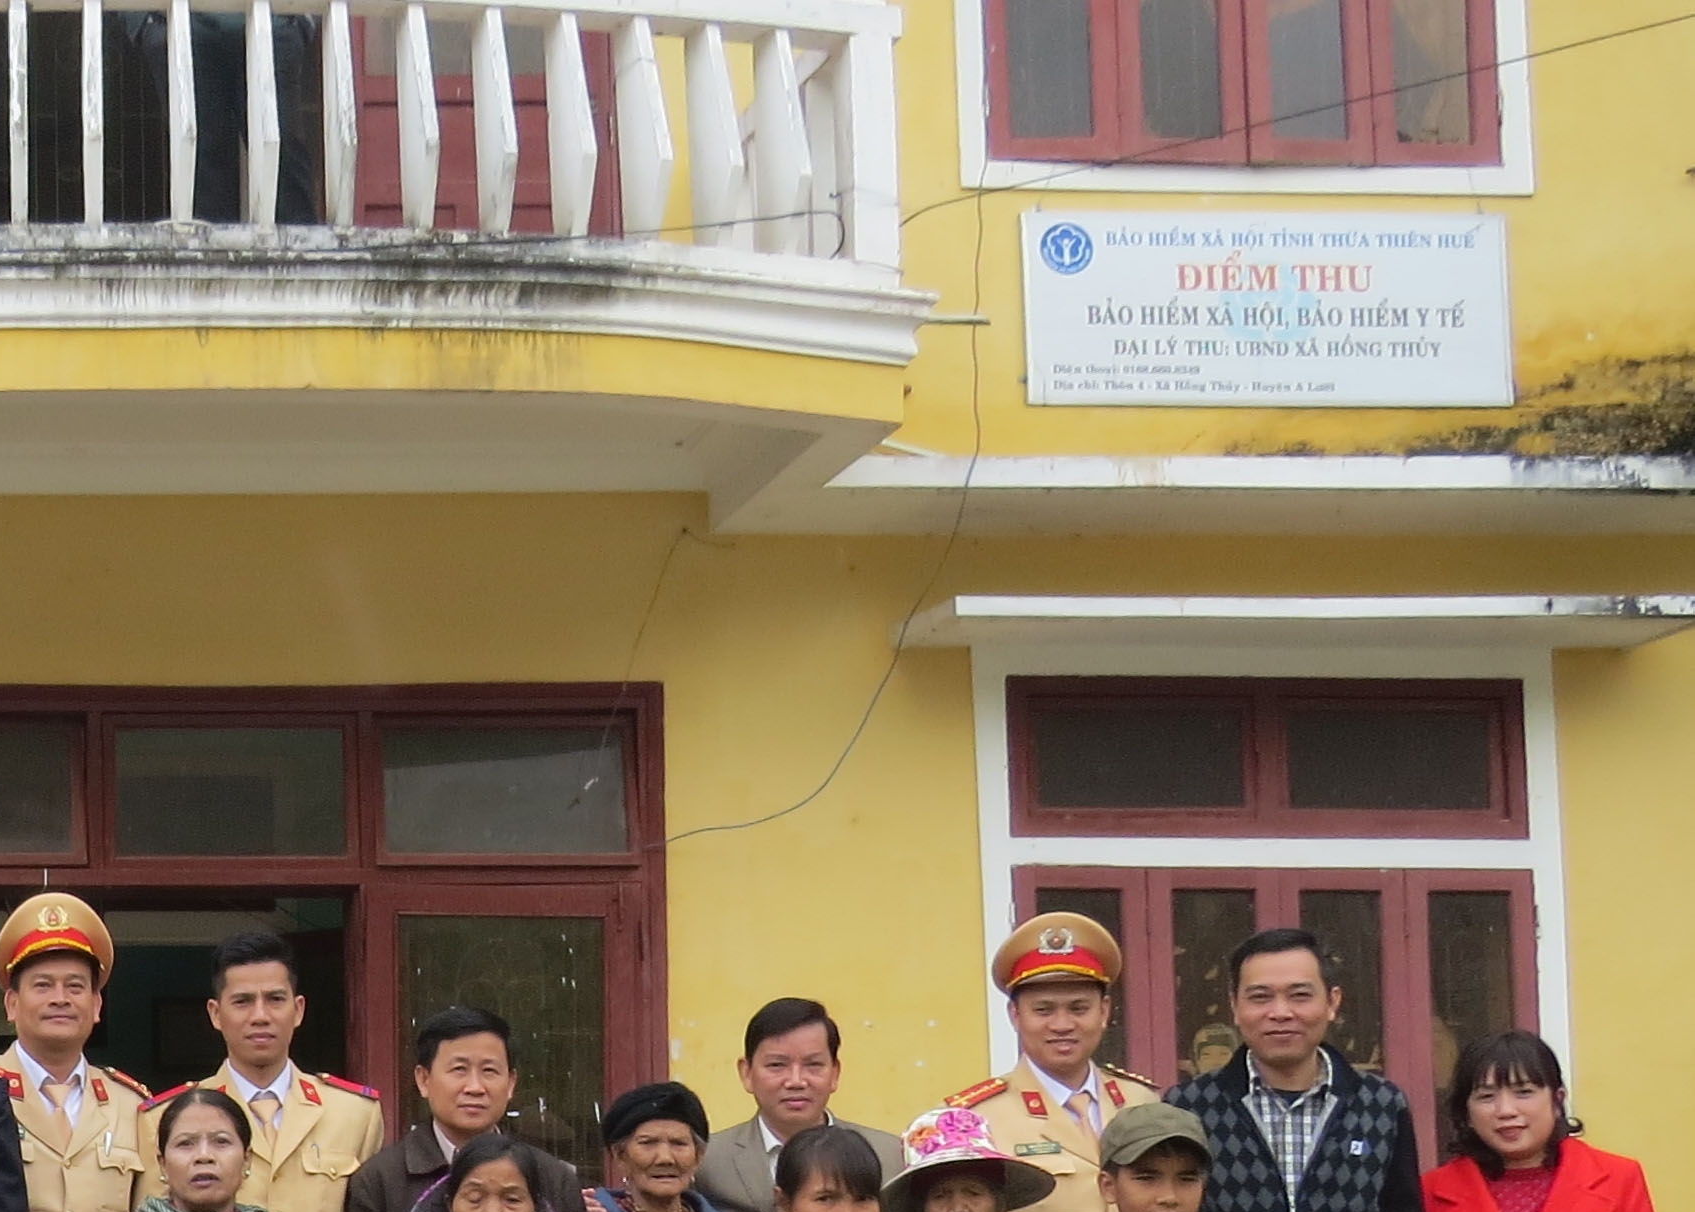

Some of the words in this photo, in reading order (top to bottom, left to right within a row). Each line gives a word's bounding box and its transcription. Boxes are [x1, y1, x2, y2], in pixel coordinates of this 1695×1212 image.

[1177, 250, 1278, 293] ĐIỂM
[1291, 264, 1373, 293] THU
[1087, 297, 1133, 326] BẢO
[1140, 296, 1198, 326] HIỂM
[1206, 302, 1234, 326] XÃ
[1243, 301, 1289, 331] HỘI,
[1297, 299, 1343, 327] BẢO
[1350, 298, 1409, 327] HIỂM
[1416, 307, 1430, 327] Y
[1436, 299, 1465, 328] TẾ
[1154, 335, 1178, 356] LÝ
[1184, 340, 1229, 356] THU:
[1235, 340, 1289, 357] UBND
